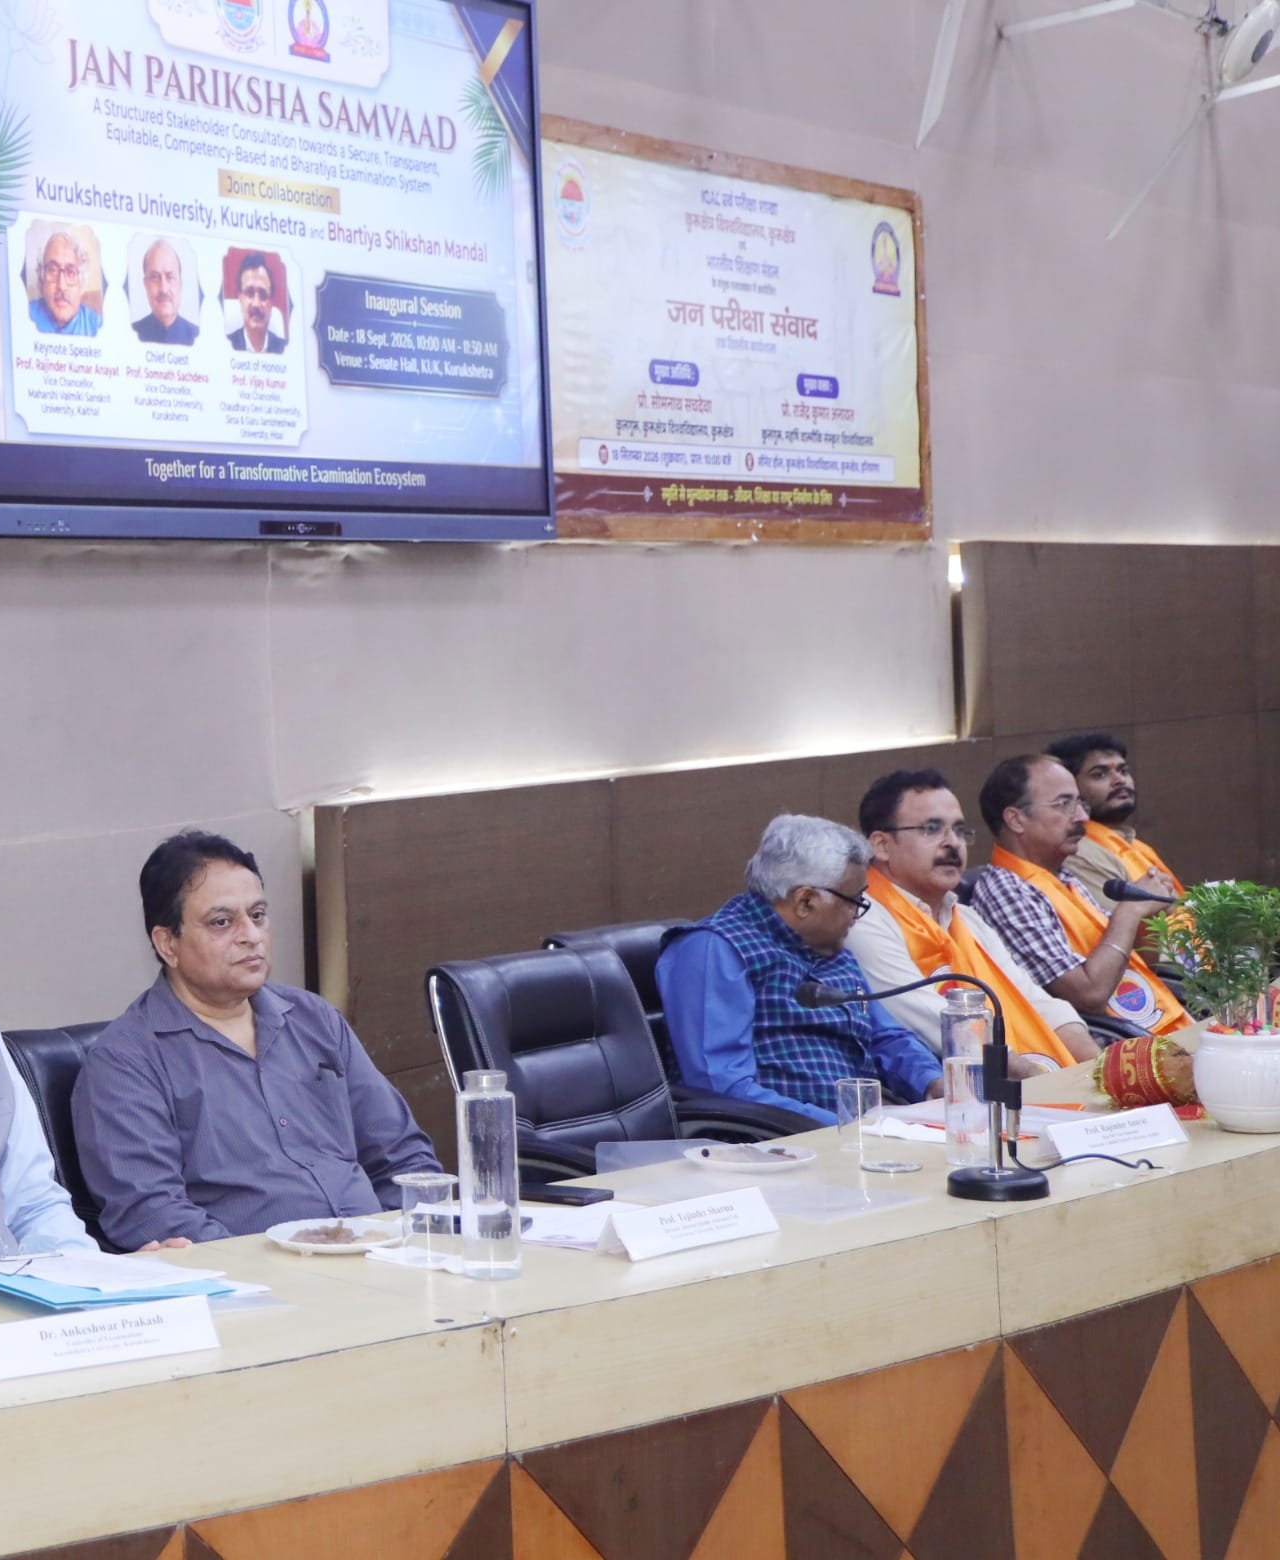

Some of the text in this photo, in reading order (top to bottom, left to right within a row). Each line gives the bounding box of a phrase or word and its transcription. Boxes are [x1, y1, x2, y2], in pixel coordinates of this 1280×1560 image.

[69, 38, 457, 151] JAN PARIKSHA SAMVAAD
[93, 97, 440, 177] A Structured Stakeholder Consultation towards a Secure, Transparent,
[106, 122, 433, 195] Equitable, Competency-Based and Bharatiya Examination System
[227, 176, 333, 209] Joint Collaboration
[36, 176, 133, 212] Kurukshetra
[138, 192, 216, 229] University,
[221, 205, 306, 237] Kurukshetra
[328, 221, 381, 251] Bhartiya
[385, 229, 441, 257] Shikshan
[445, 239, 488, 264] Mandal
[365, 290, 462, 320] Inaugural Session
[666, 298, 818, 340] जन परीक्षा संवाद
[328, 325, 350, 343] Date
[441, 338, 456, 354] AM
[334, 351, 363, 368] Venue
[369, 354, 398, 371] Senate
[444, 360, 494, 380] Kurukshetra
[145, 458, 426, 490] Together for a Transformative Examination Ecosystem
[39, 1329, 57, 1341] Dr.
[121, 1314, 164, 1329] Prakash
